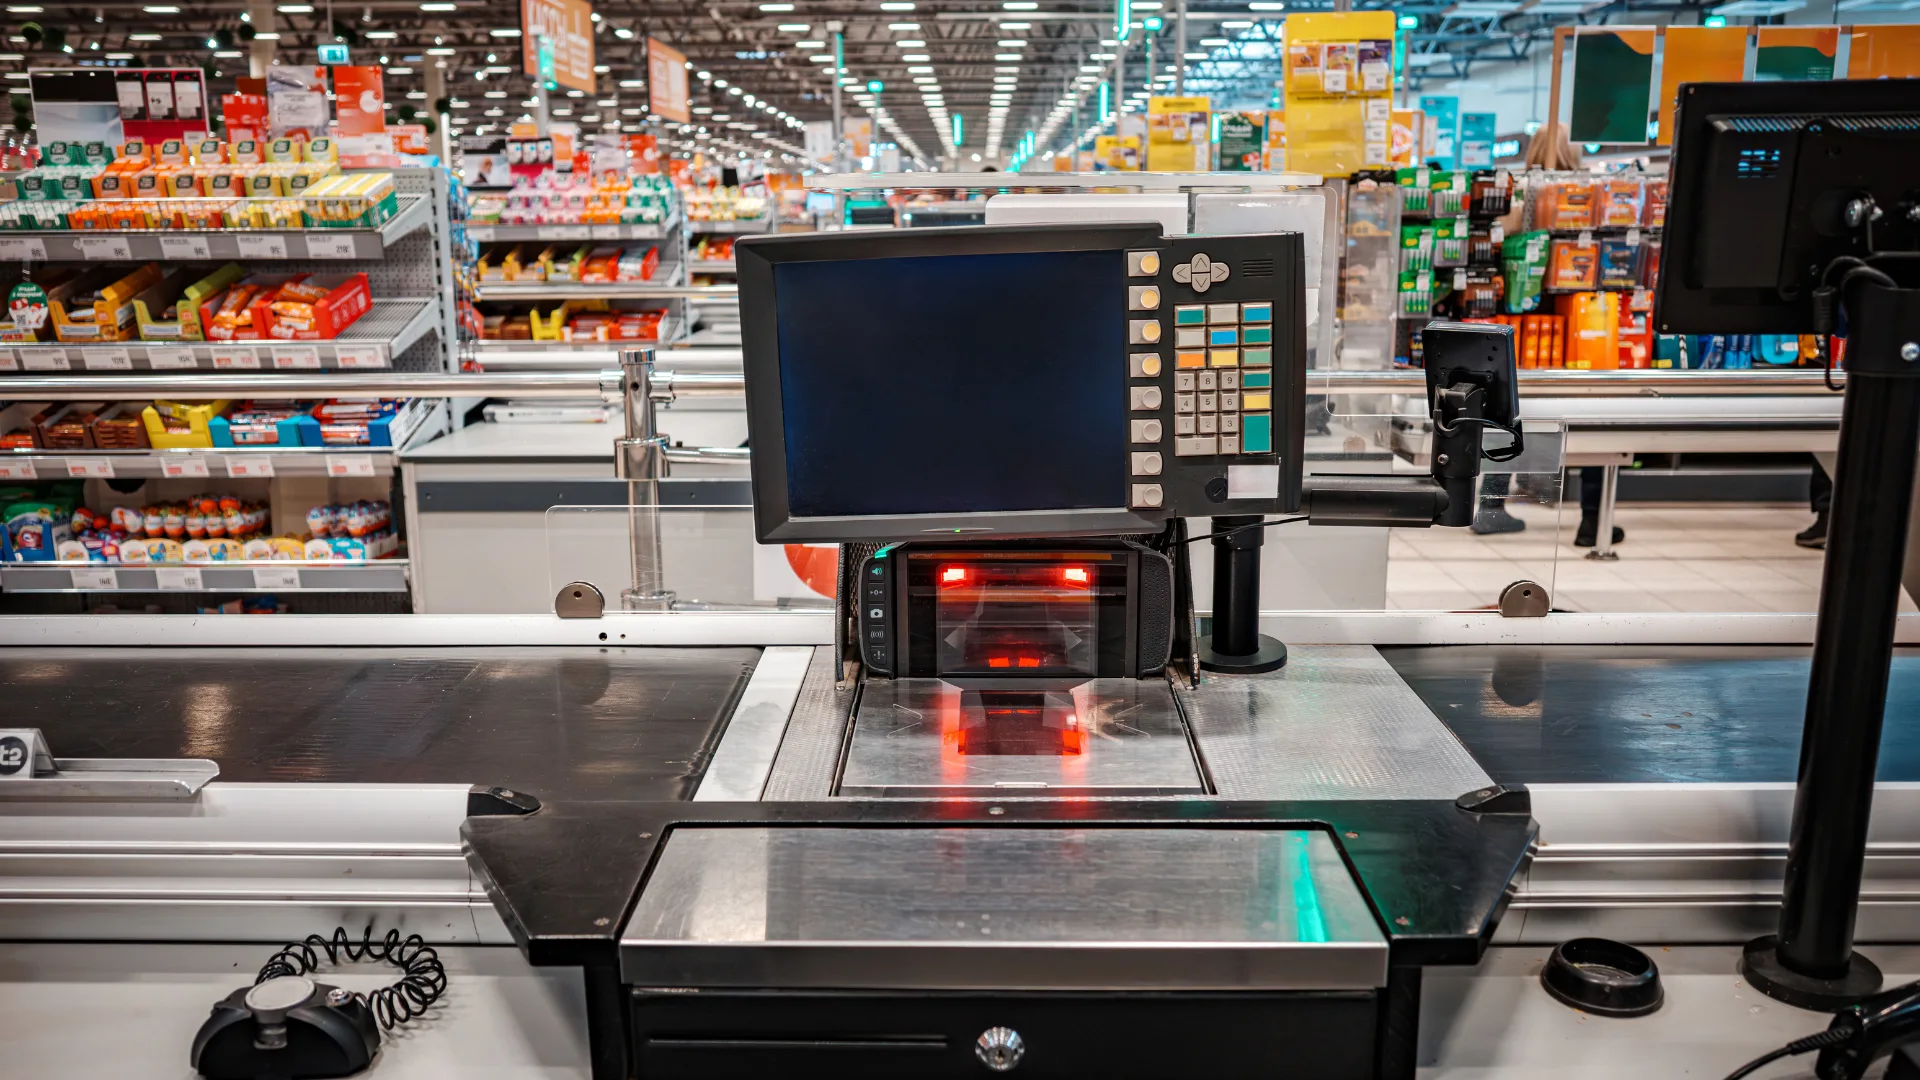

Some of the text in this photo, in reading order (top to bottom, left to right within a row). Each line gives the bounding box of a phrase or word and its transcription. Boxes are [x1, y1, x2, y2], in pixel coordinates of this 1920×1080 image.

[1183, 376, 1233, 386] 7 8 9
[1205, 398, 1211, 406] 5
[1227, 398, 1233, 406] 6
[1227, 420, 1233, 428] 3
[0, 744, 22, 766] t2
